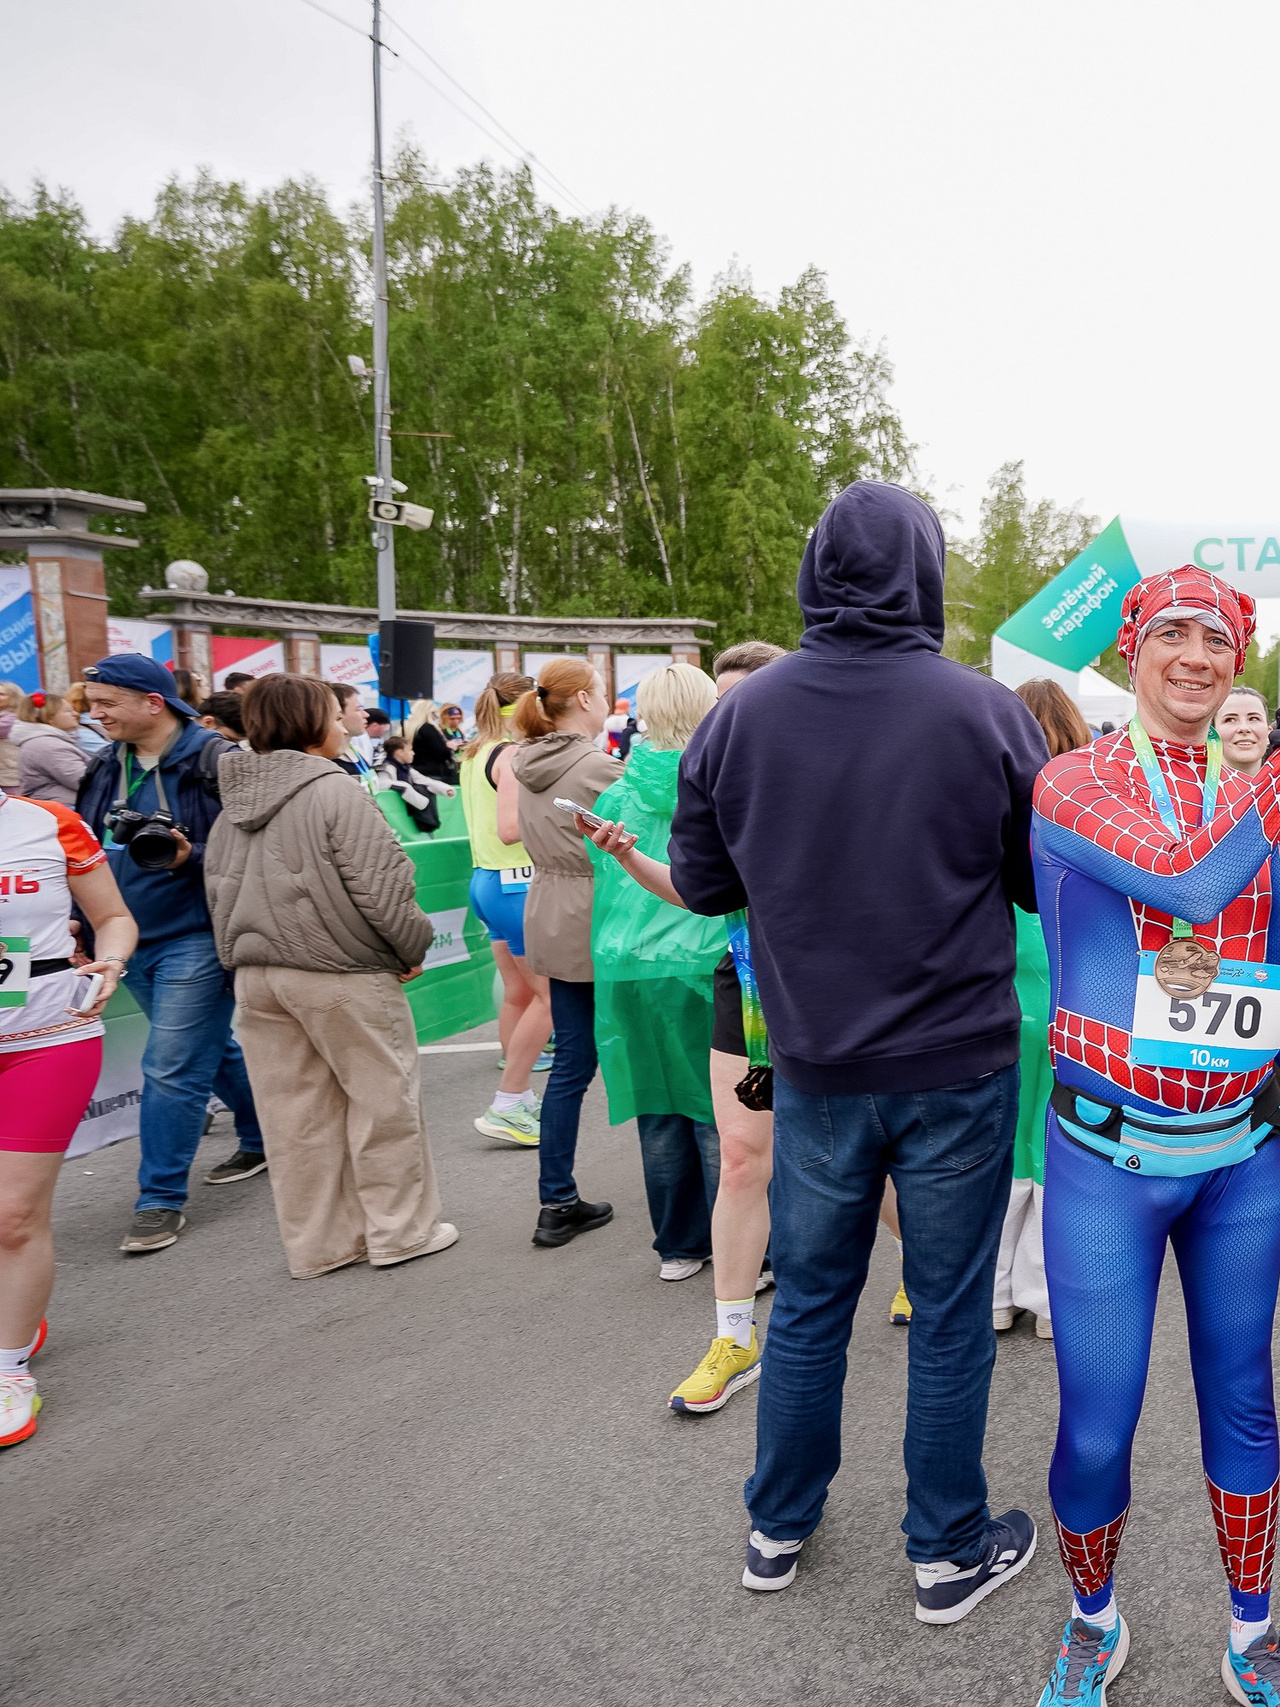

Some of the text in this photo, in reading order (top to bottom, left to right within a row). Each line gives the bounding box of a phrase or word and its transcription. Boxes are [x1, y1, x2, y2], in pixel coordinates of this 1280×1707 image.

[1041, 563, 1107, 629] зелёный
[1052, 577, 1119, 642] марафон
[1168, 992, 1262, 1039] 570
